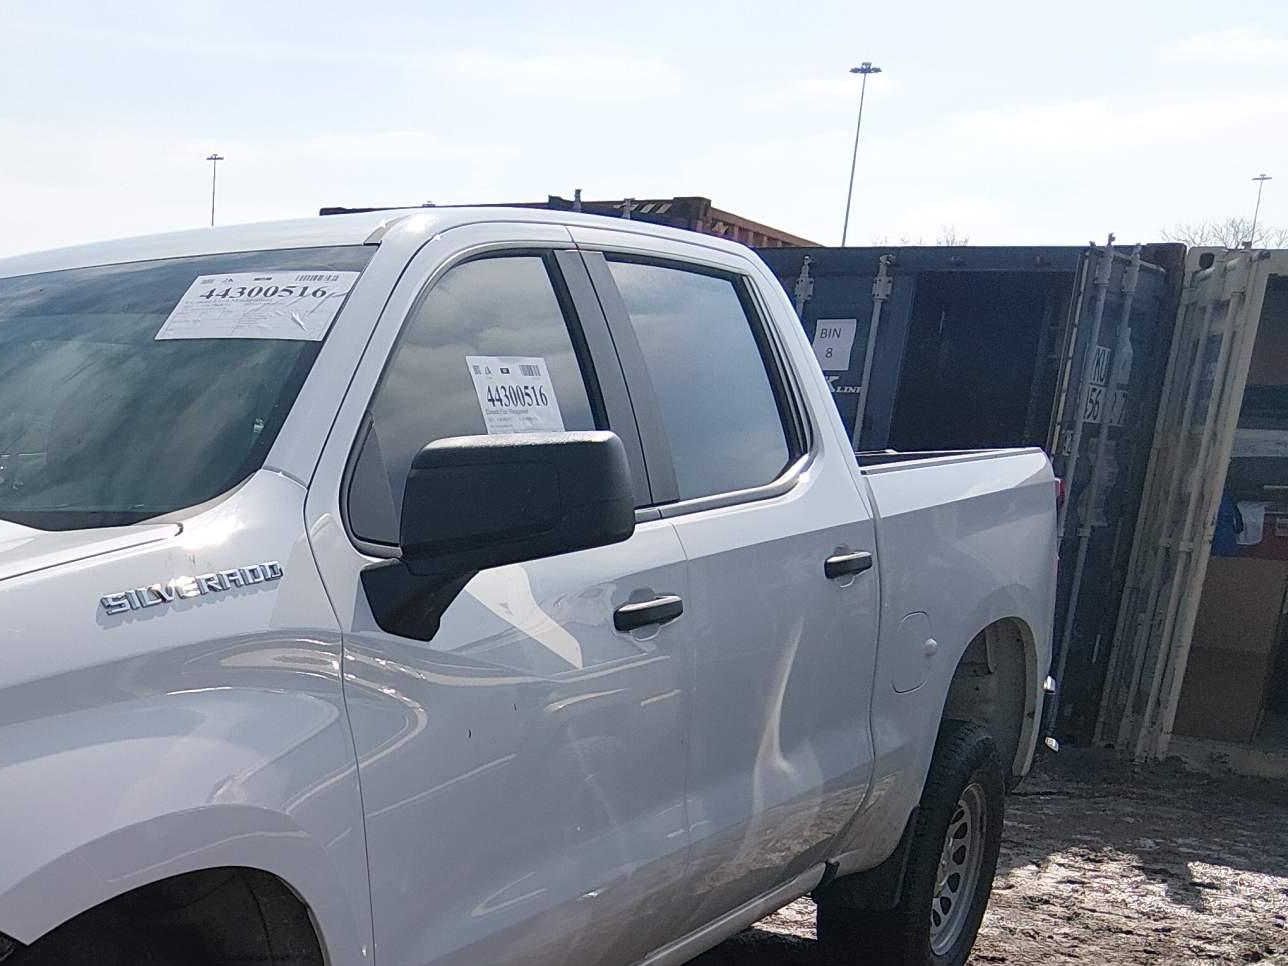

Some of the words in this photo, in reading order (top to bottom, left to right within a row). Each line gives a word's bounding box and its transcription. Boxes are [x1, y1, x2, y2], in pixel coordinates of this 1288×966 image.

[199, 285, 328, 300] 44300516
[819, 327, 842, 339] BIN
[824, 347, 833, 359] 8
[487, 385, 549, 408] 44300516
[100, 561, 283, 615] SILVERADO
